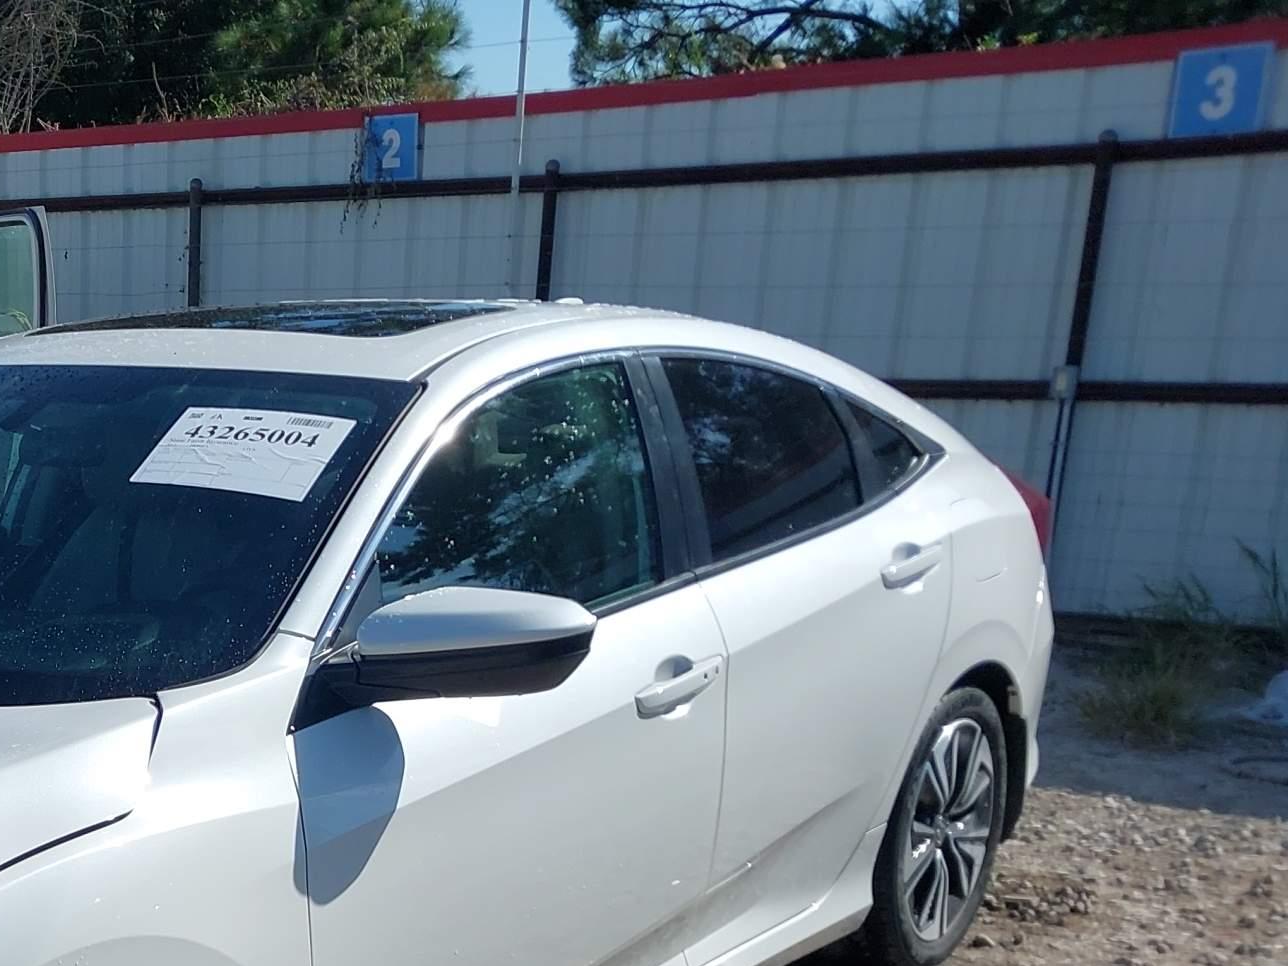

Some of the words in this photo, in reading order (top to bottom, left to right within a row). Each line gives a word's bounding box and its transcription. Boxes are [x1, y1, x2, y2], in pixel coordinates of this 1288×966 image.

[1200, 65, 1237, 120] 3
[382, 128, 401, 169] 2
[184, 424, 320, 448] 43265004
